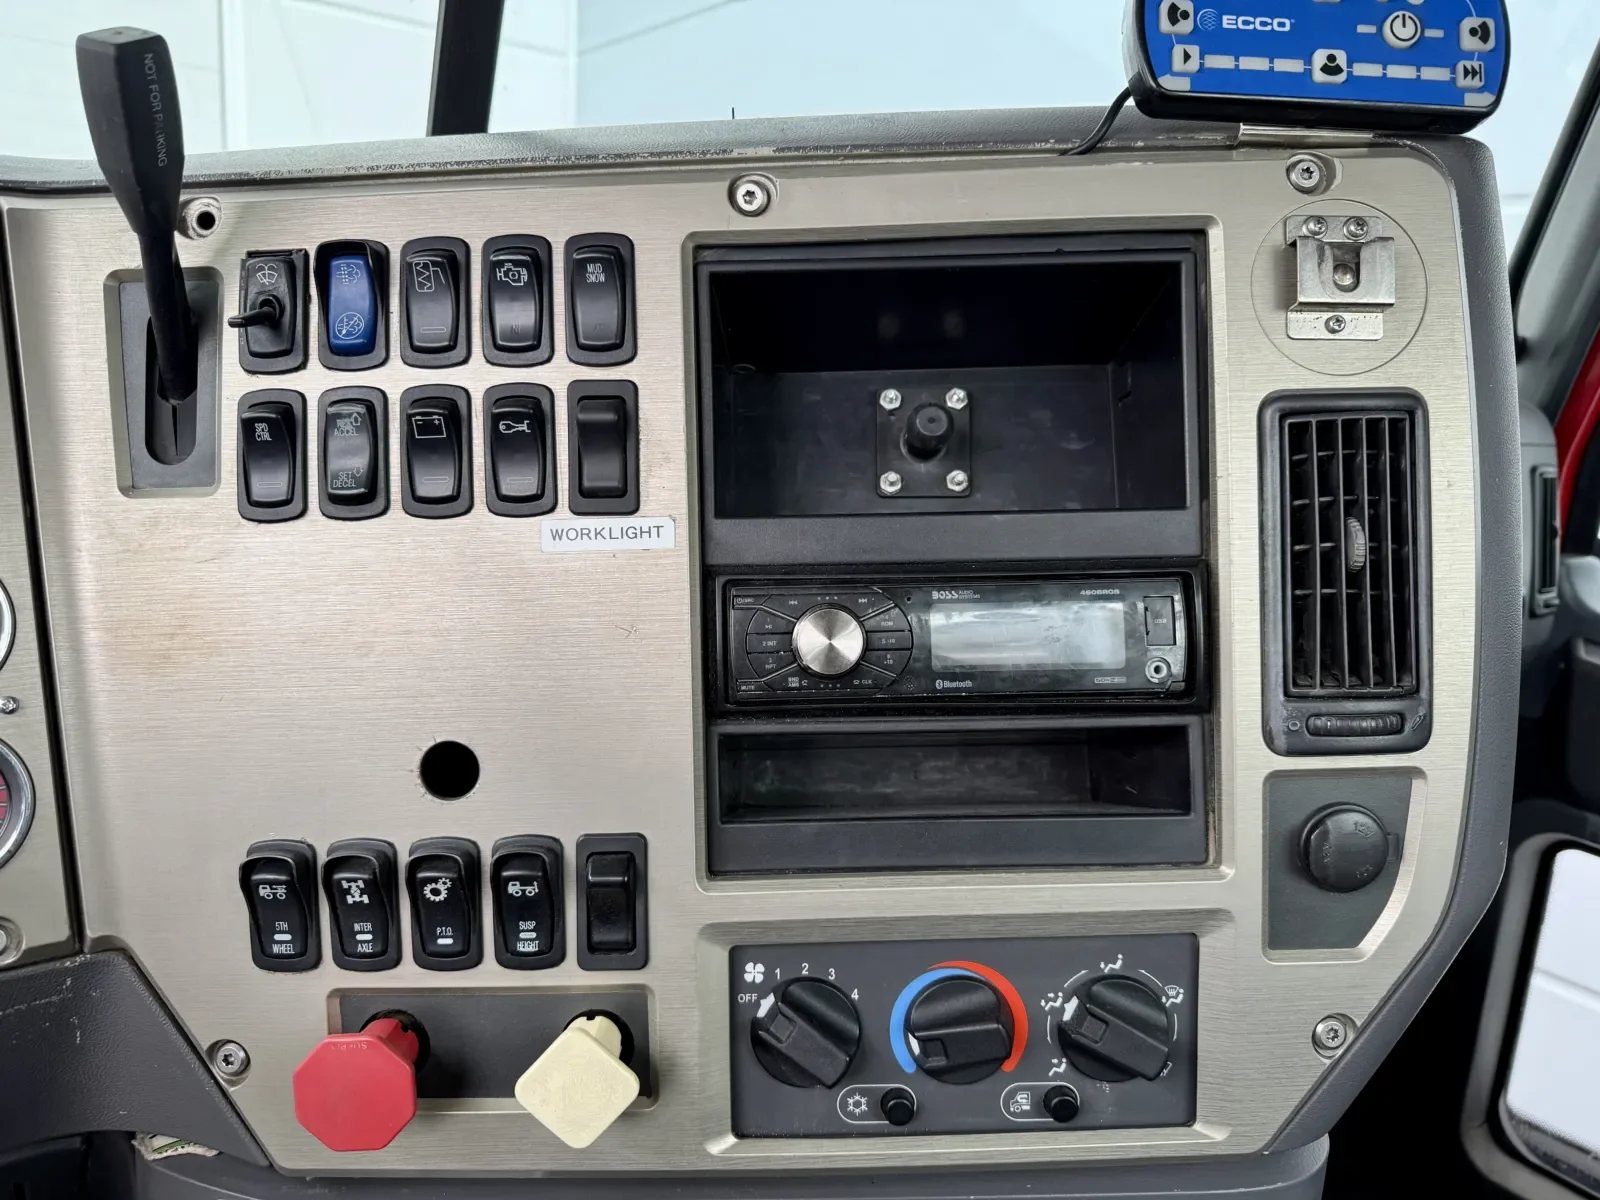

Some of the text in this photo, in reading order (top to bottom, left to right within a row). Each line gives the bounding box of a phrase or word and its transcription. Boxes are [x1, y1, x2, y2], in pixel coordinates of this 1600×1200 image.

[1222, 15, 1291, 32] ECCO
[144, 53, 156, 80] NOT
[149, 84, 161, 111] FOR
[586, 263, 603, 273] MUD
[585, 273, 605, 283] SNOW
[254, 423, 269, 432] SPD
[334, 428, 359, 437] ACCEL
[255, 432, 273, 441] CTRL
[338, 471, 353, 480] SET
[333, 479, 356, 488] DECEL
[550, 525, 665, 542] WORKLIGHT
[931, 590, 959, 600] BOSS
[943, 680, 973, 688] Bluetooth
[275, 922, 289, 931] 5TH
[353, 922, 373, 932] INTER
[519, 920, 536, 930] SUSP
[272, 943, 295, 954] WHEEL
[357, 943, 374, 953] AXLE
[516, 940, 540, 951] HEIGHT
[774, 968, 781, 980] 1
[801, 963, 809, 975] 2
[828, 968, 836, 980] 3
[737, 993, 758, 1003] OFF
[851, 988, 859, 1000] 4
